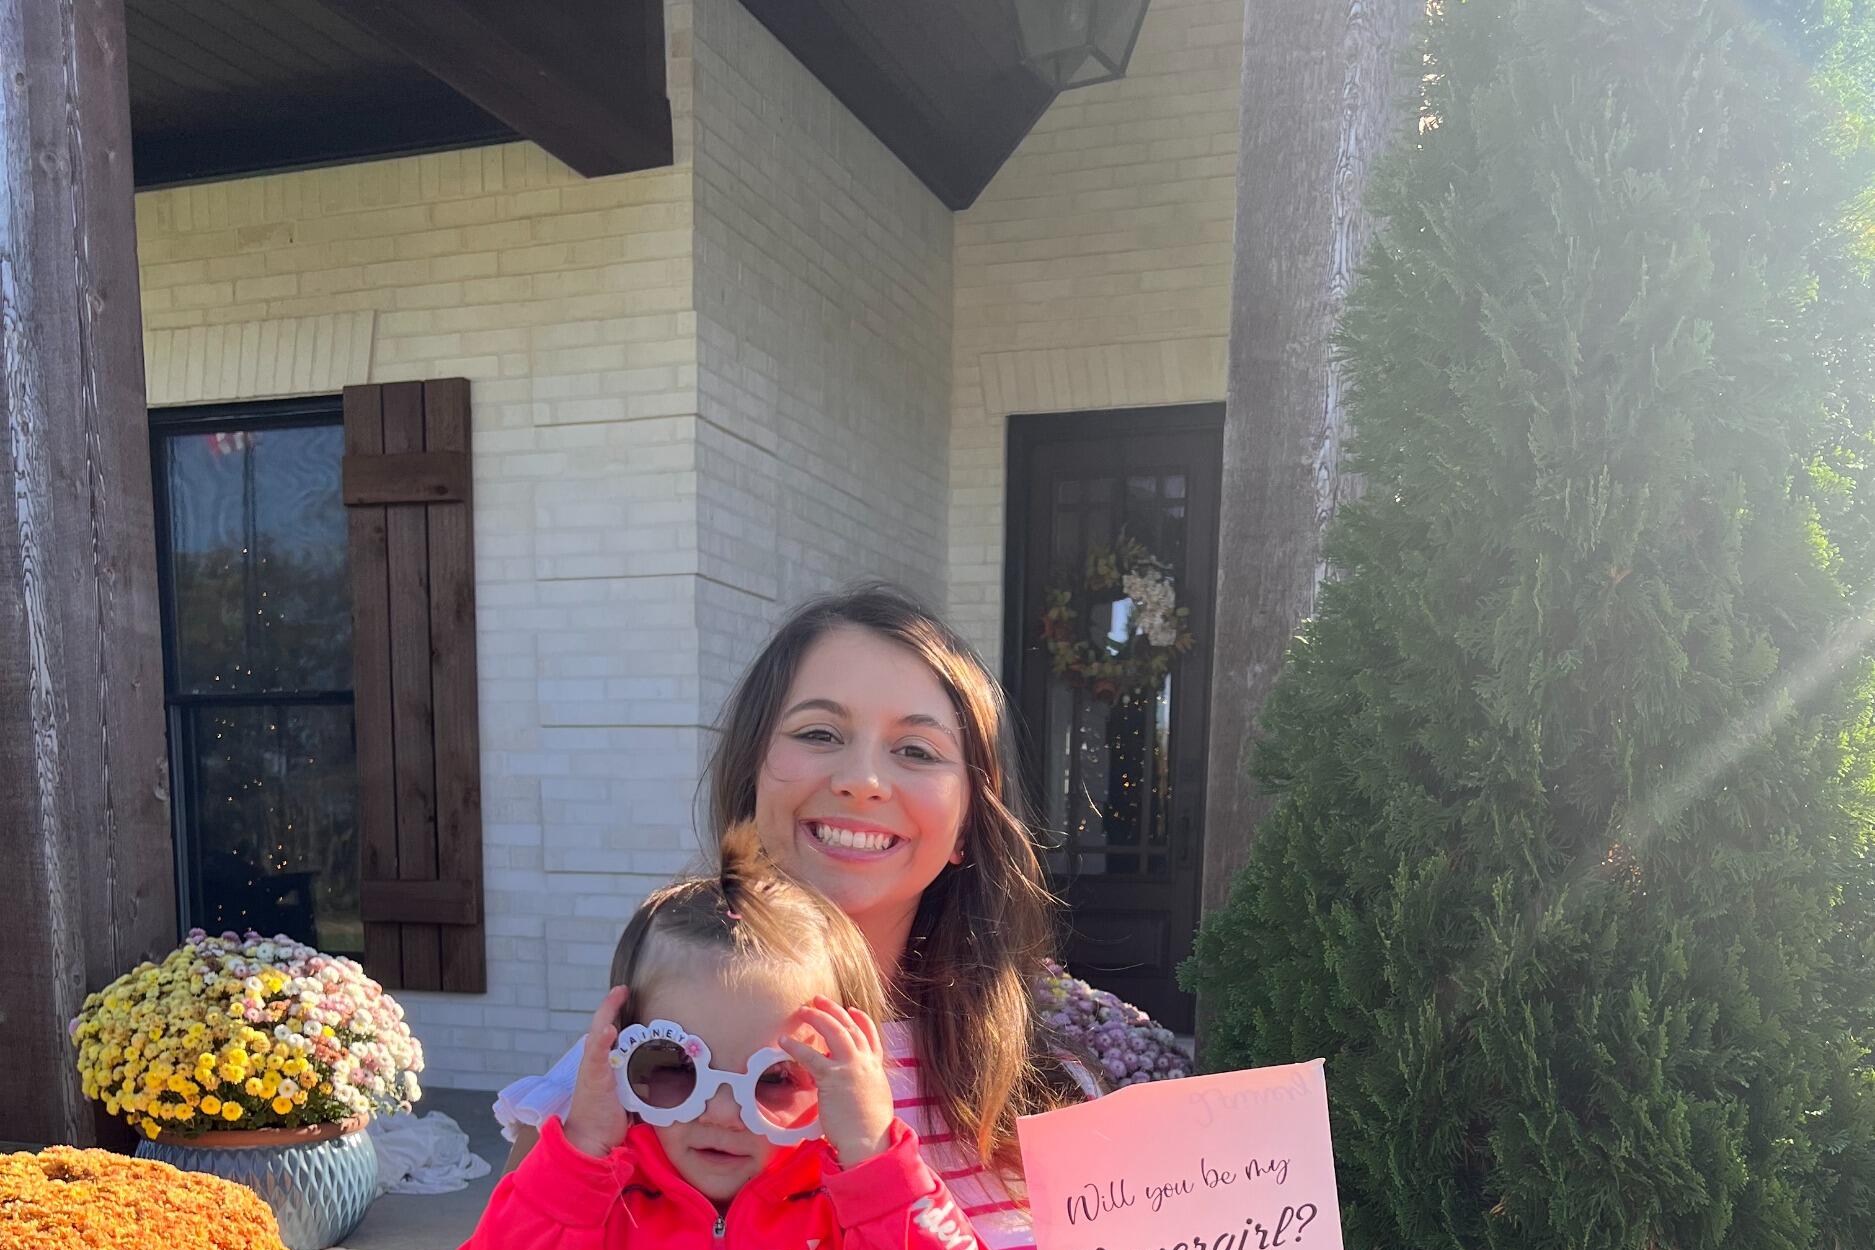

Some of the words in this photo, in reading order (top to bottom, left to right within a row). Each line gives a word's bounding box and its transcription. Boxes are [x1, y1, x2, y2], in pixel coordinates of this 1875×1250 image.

[619, 1029, 685, 1053] LAINEY
[1066, 1178, 1135, 1226] Will
[1145, 1179, 1194, 1212] you
[1200, 1157, 1236, 1189] be
[1245, 1158, 1290, 1184] my
